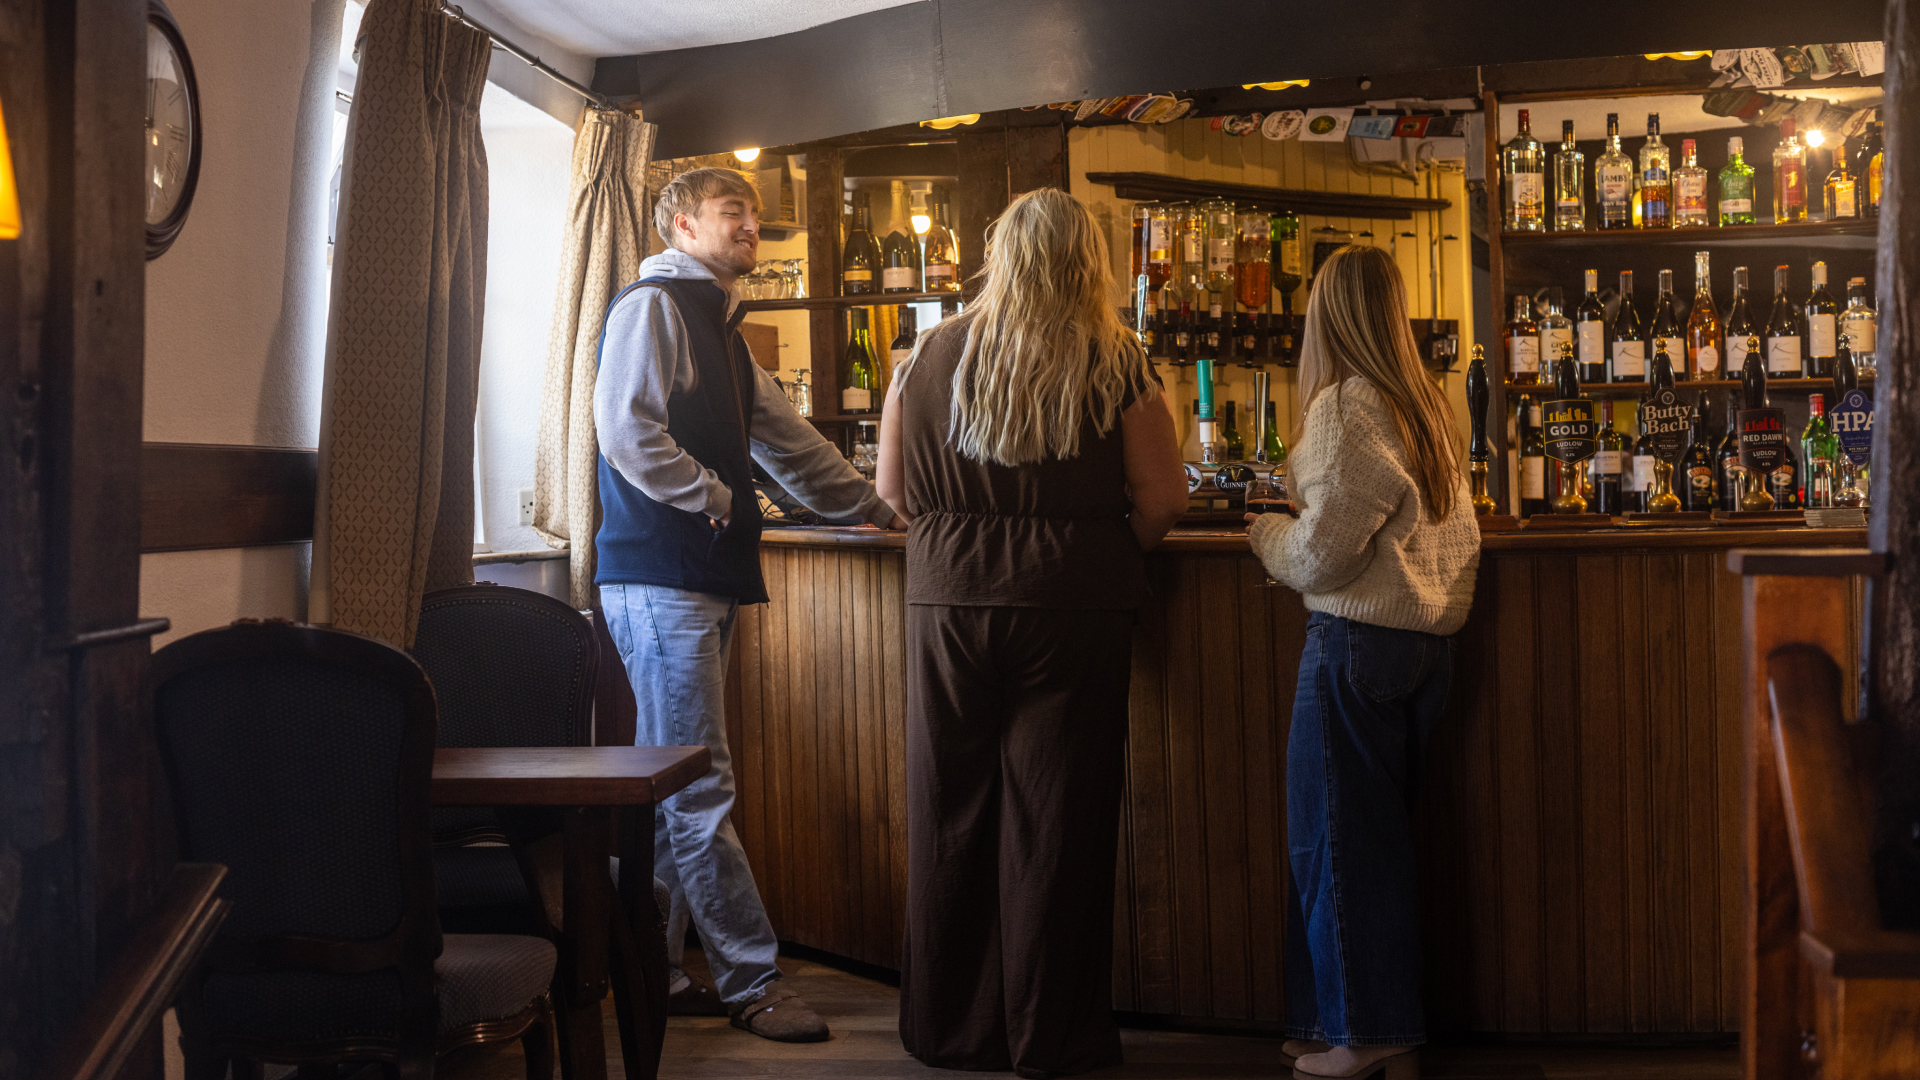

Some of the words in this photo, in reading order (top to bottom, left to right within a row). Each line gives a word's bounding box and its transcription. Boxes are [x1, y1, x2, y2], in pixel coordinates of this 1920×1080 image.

[1644, 405, 1692, 421] Butty
[1646, 416, 1690, 435] Bach
[1831, 411, 1874, 432] HPA
[1550, 424, 1588, 436] GOLD
[1743, 434, 1760, 442] RED
[1762, 433, 1783, 441] DAWN
[1220, 481, 1248, 489] GUINNES
